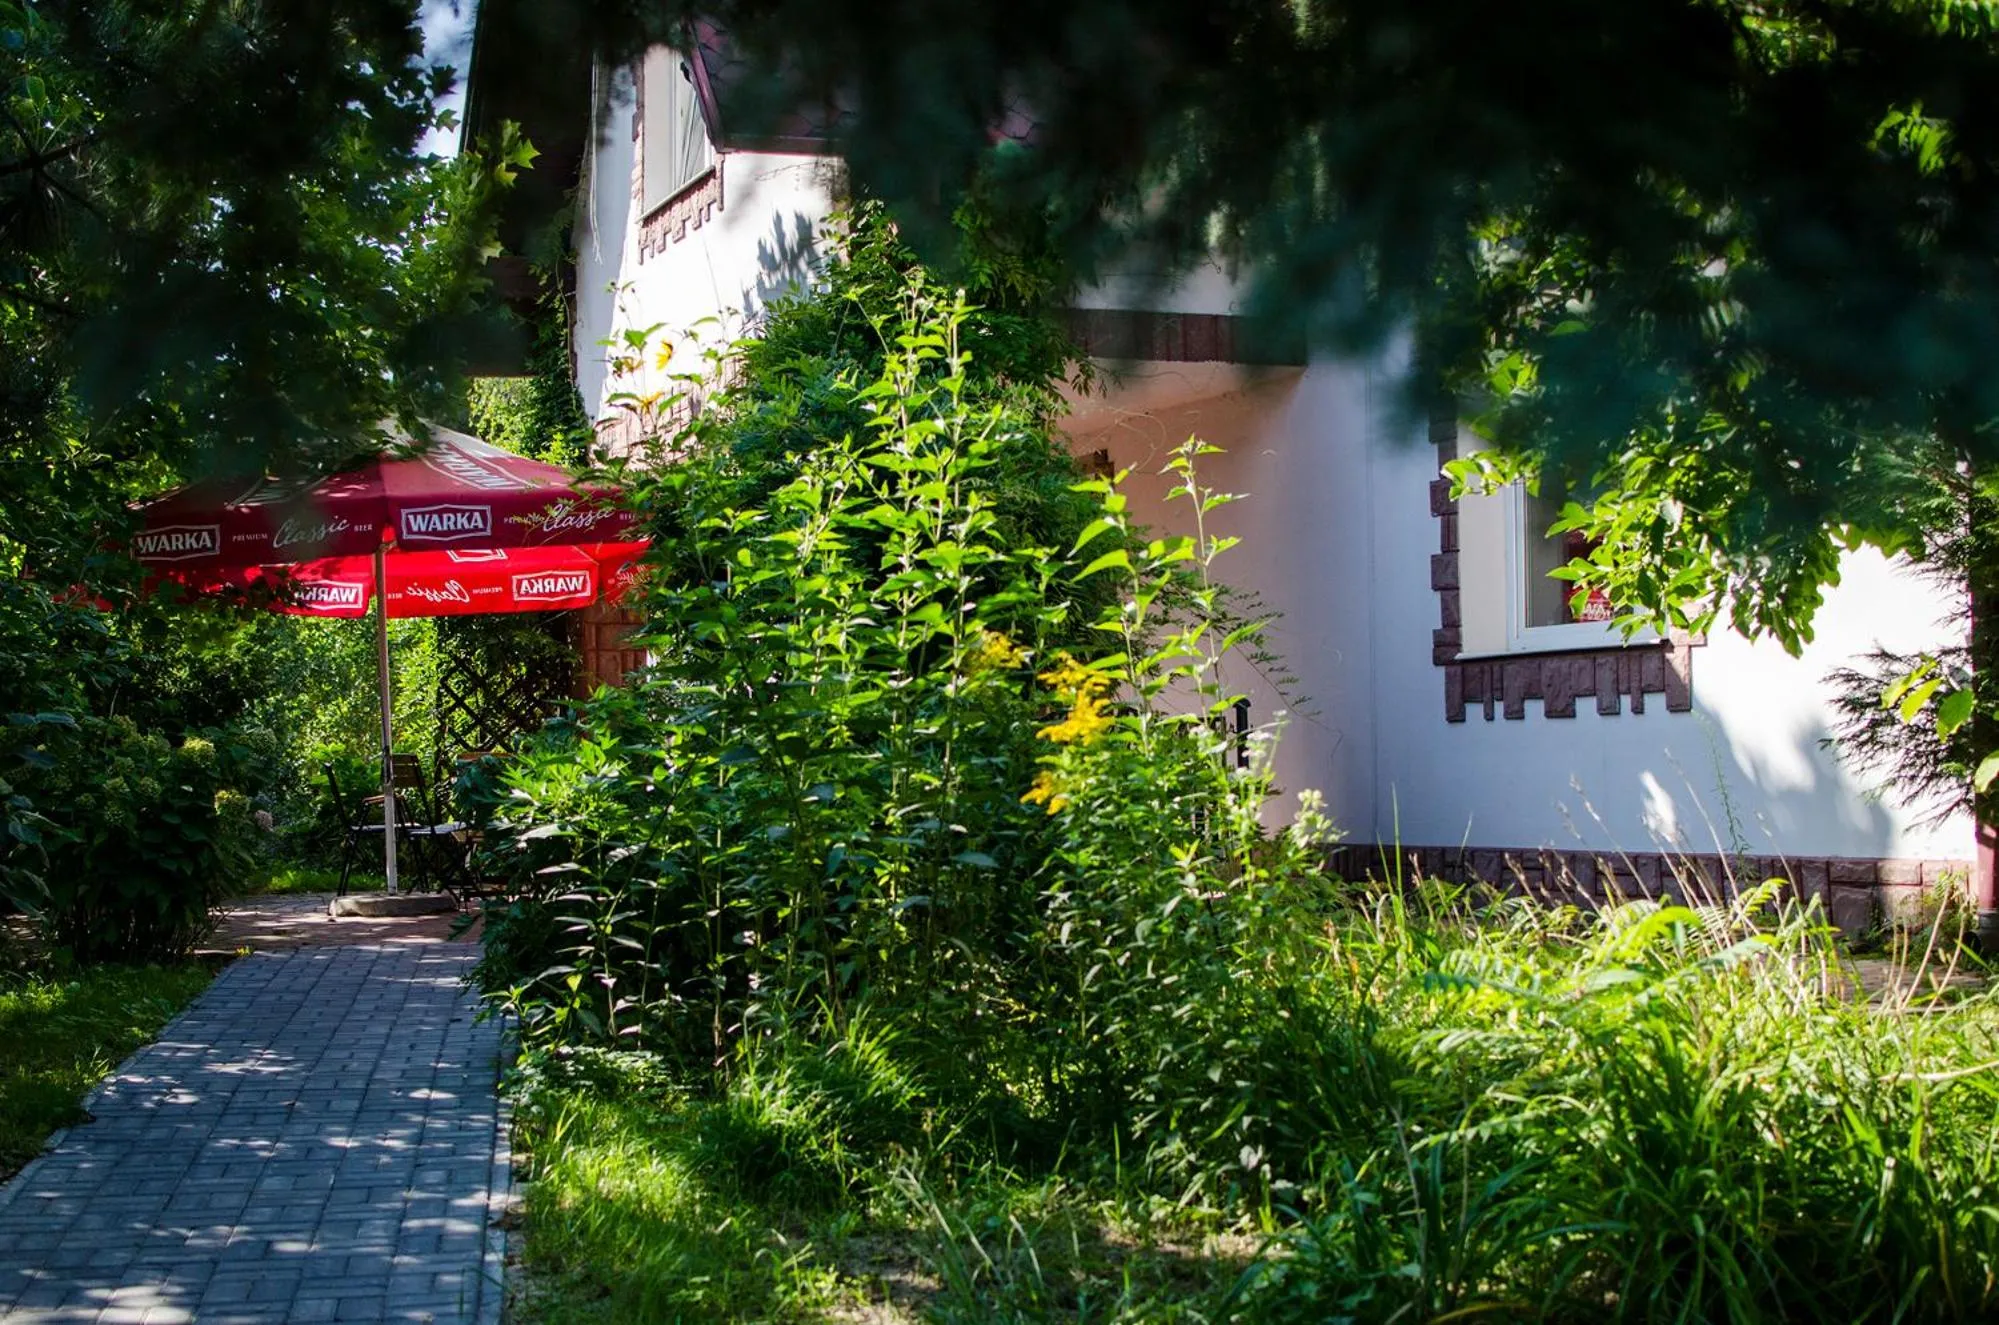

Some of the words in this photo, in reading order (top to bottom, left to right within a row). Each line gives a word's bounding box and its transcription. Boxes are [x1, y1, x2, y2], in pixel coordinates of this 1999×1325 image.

[137, 530, 212, 554] WARKA
[232, 532, 268, 542] PREMIUM
[272, 515, 350, 548] Classic
[353, 523, 373, 532] BEER
[408, 511, 484, 533] WARKA
